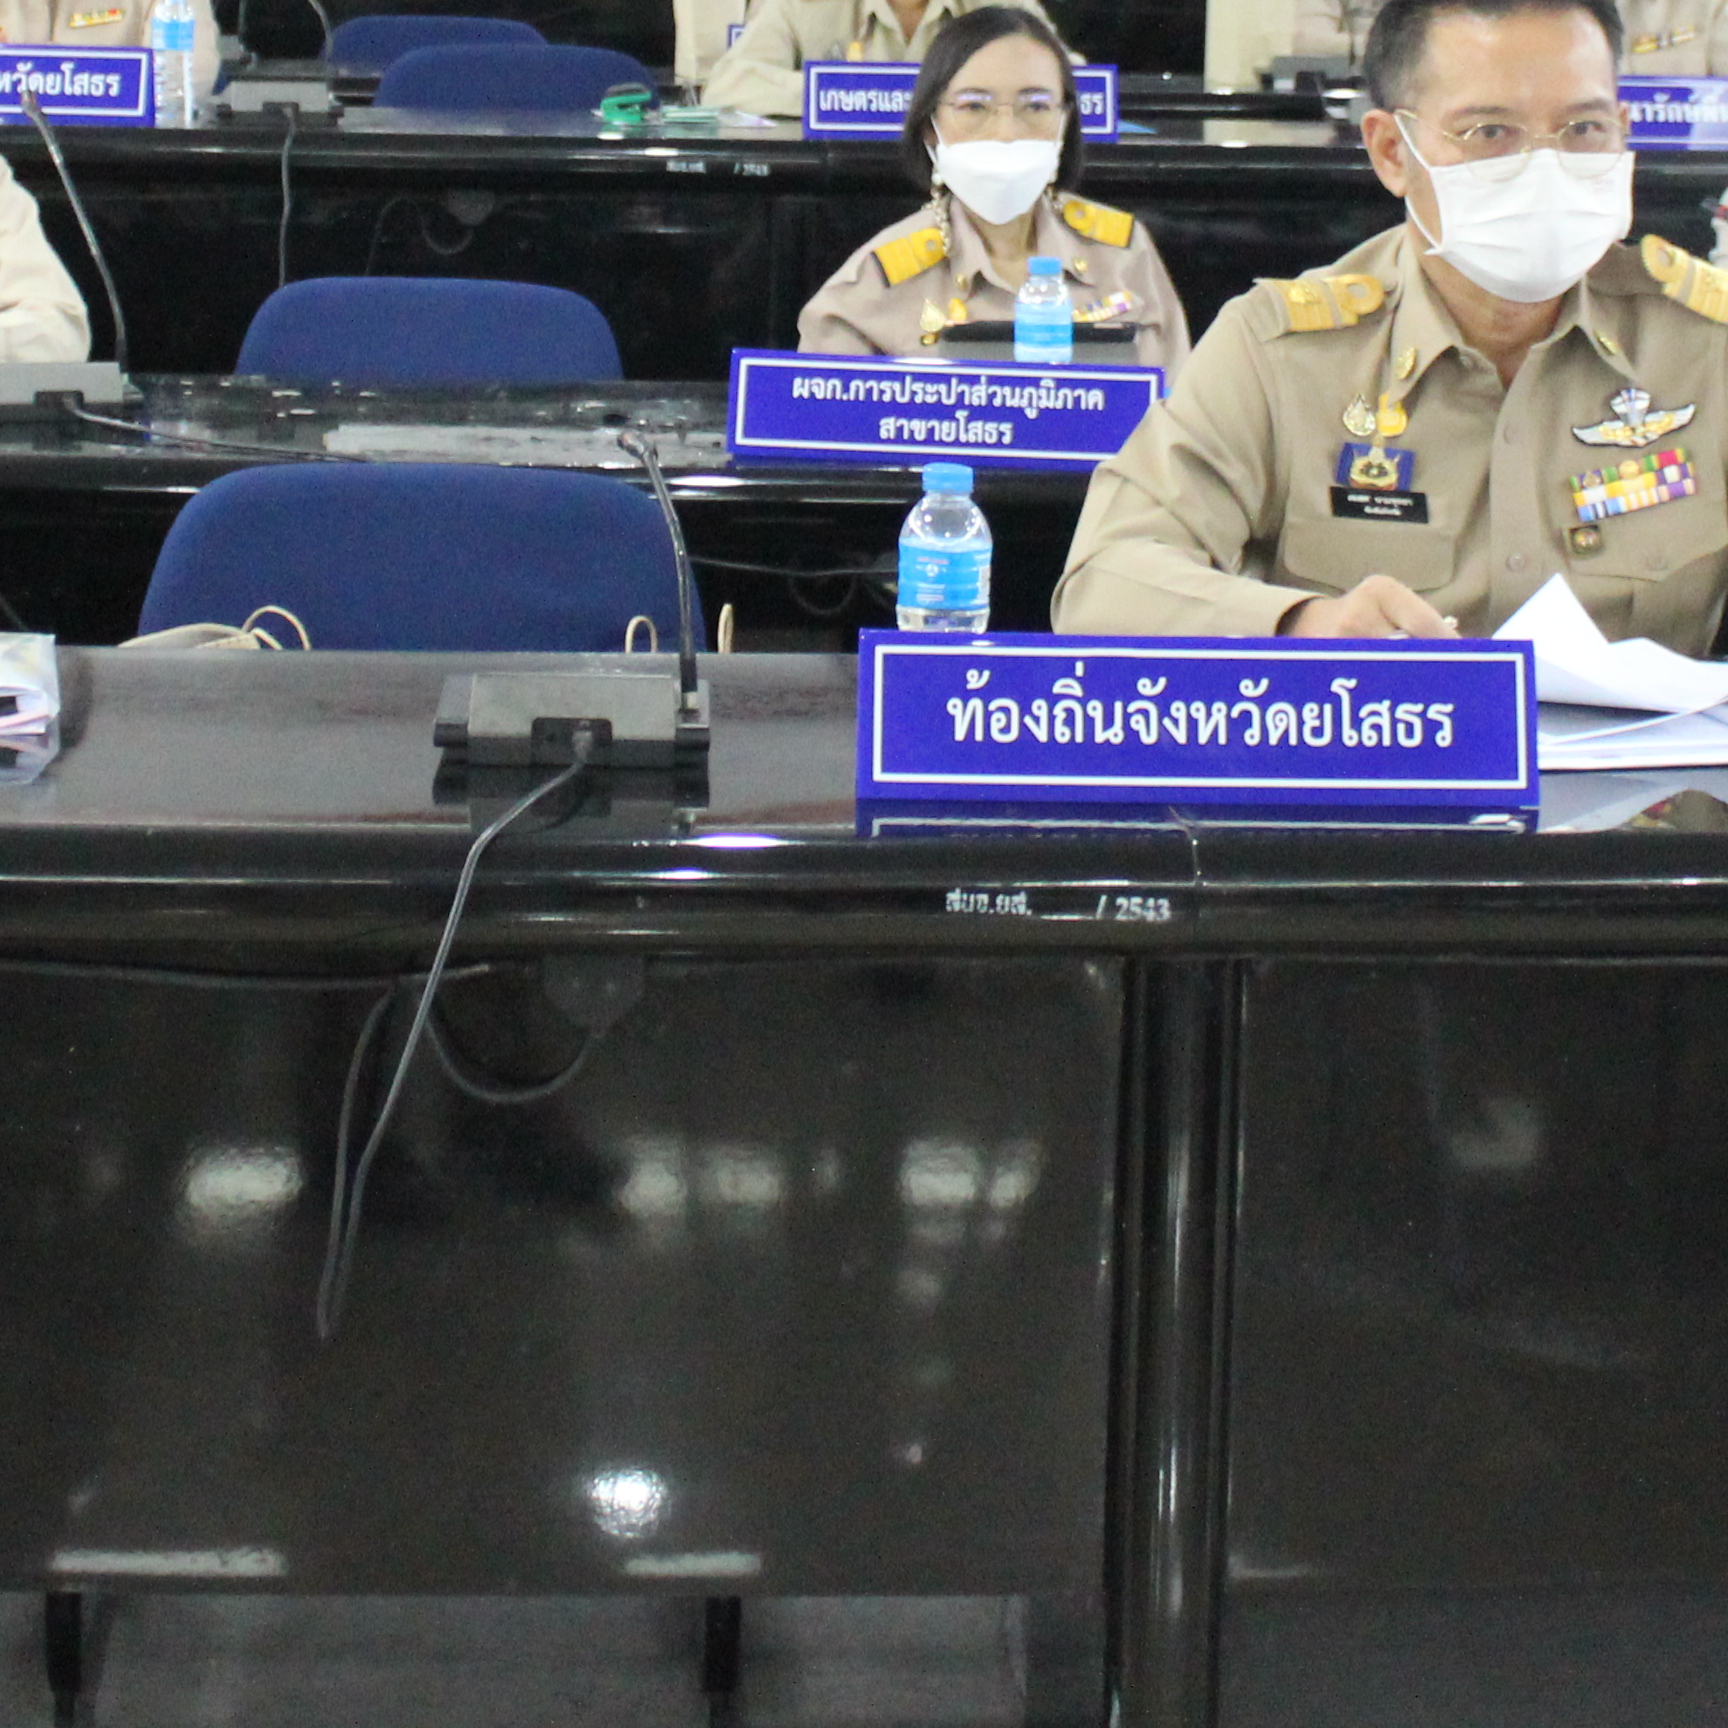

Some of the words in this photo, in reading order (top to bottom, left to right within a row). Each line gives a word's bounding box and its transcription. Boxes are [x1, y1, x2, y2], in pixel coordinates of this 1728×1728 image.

[792, 375, 1105, 419] ผจก.การประปาส่วนภูมิภาค
[879, 410, 1014, 445] สาขายโสธร
[946, 660, 1455, 749] ท้องถิ่นจังหวัดยโสธร
[1114, 895, 1172, 922] 2543
